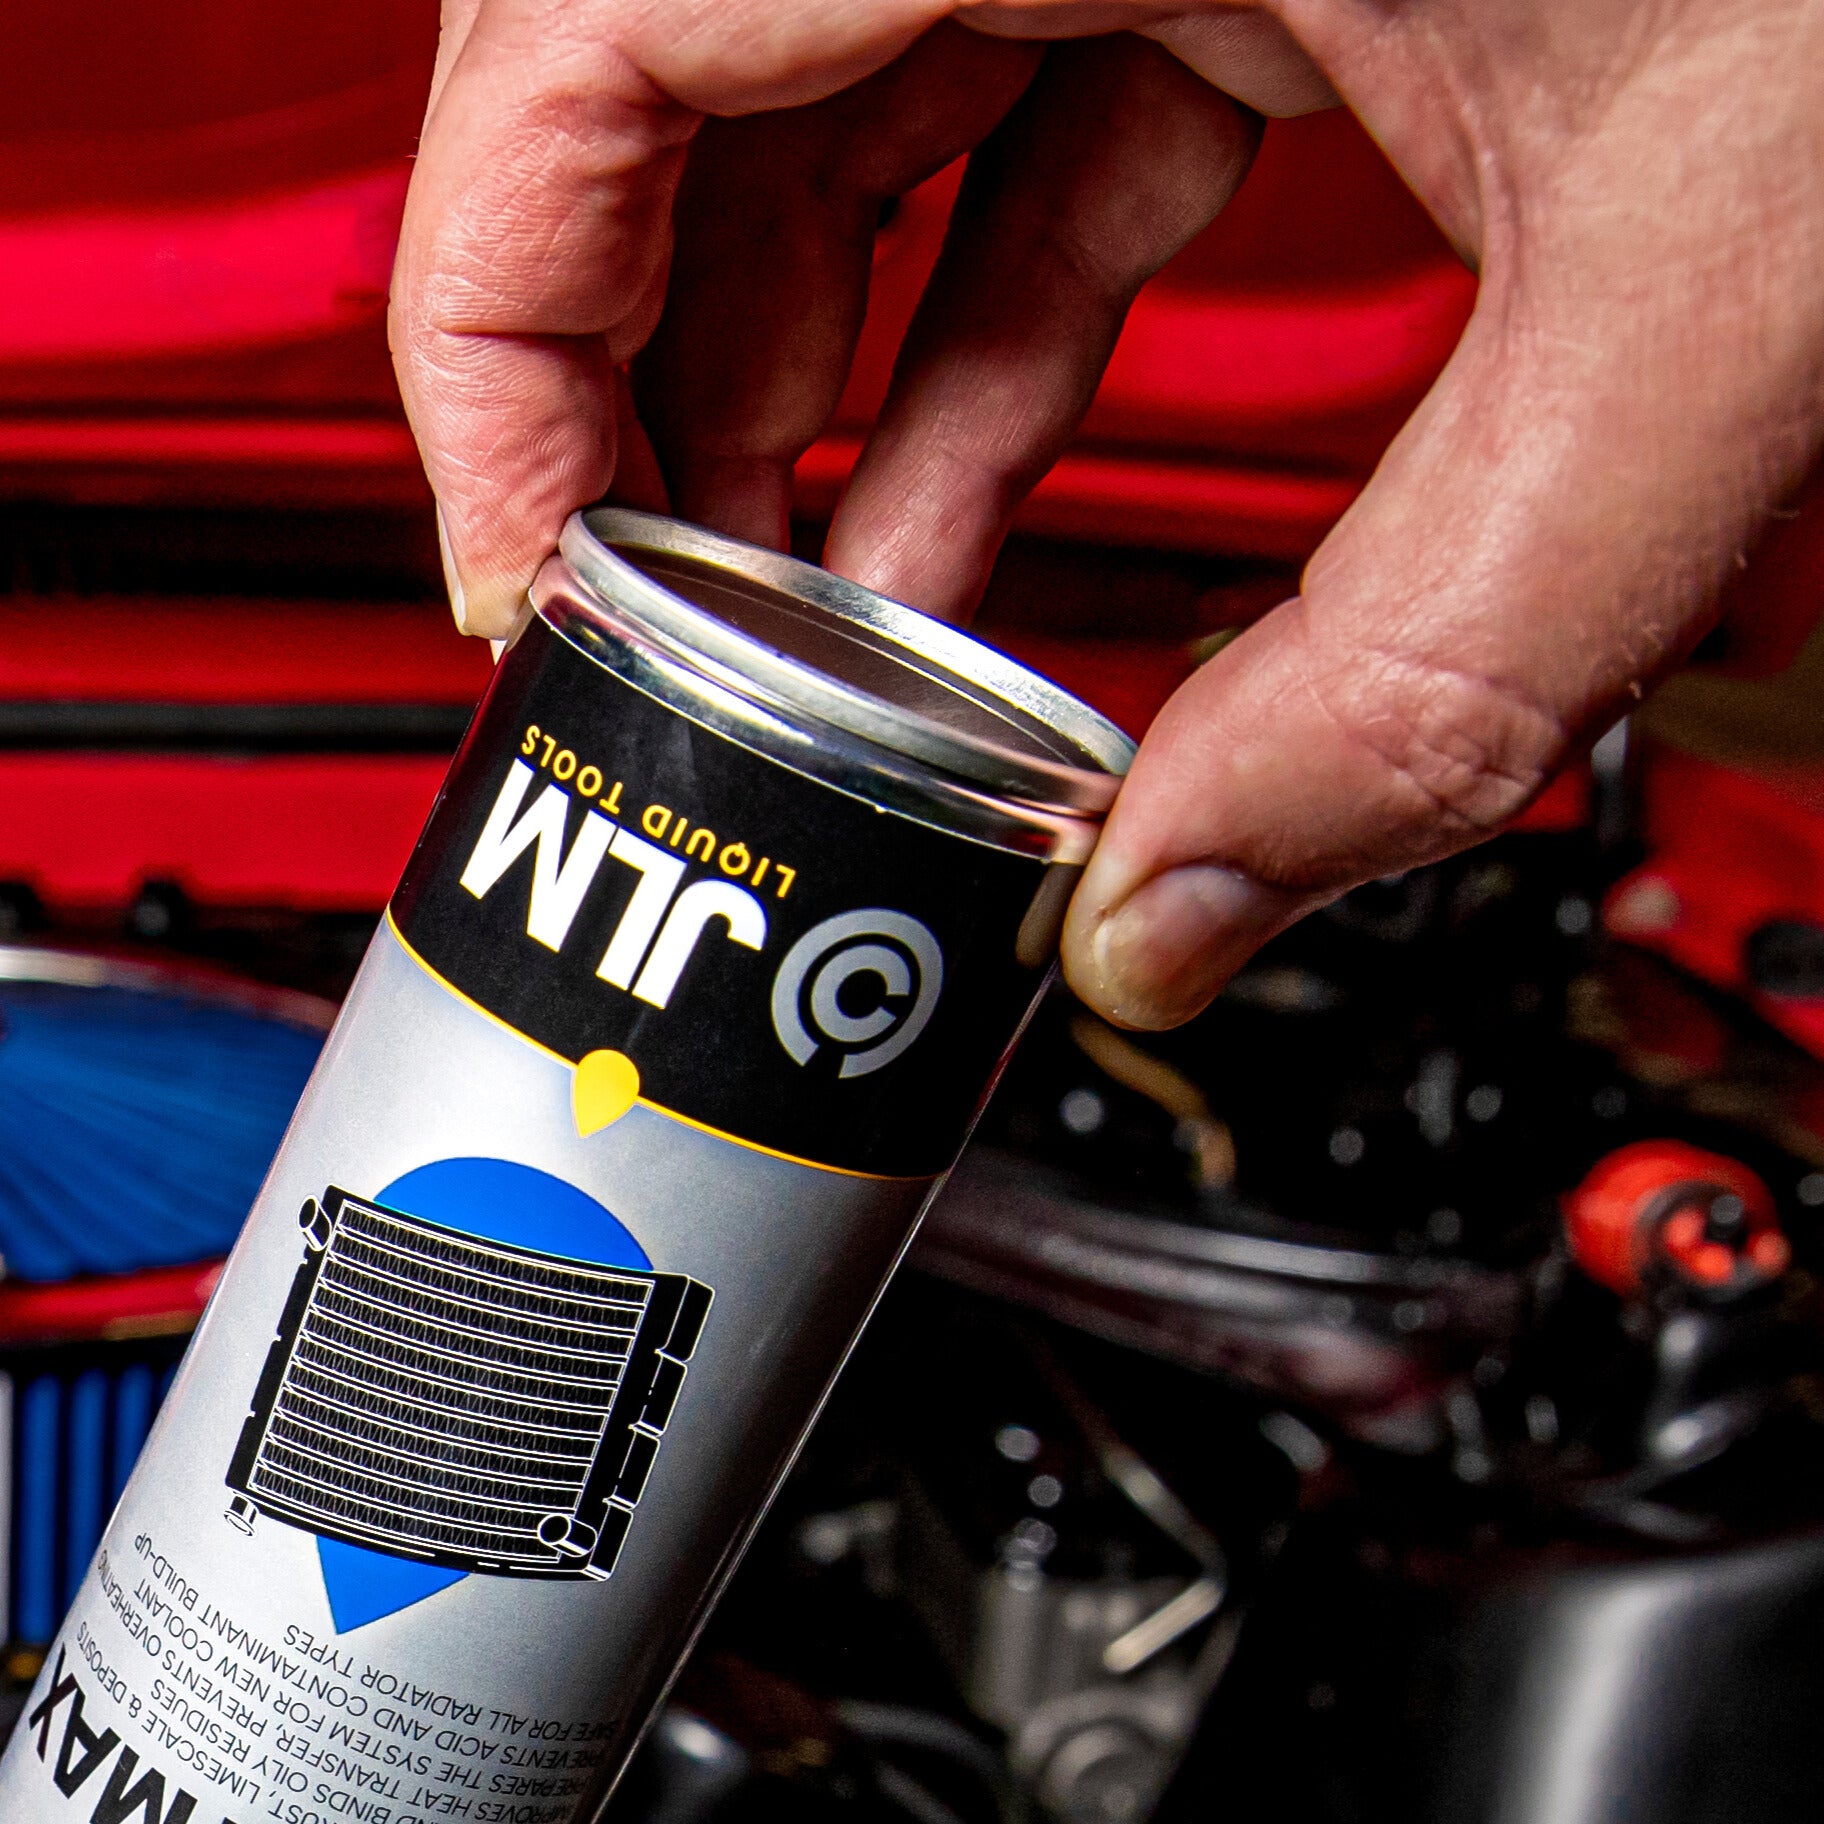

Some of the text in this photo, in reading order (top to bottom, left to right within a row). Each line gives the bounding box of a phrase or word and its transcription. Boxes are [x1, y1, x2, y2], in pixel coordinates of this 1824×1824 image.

[521, 725, 795, 898] LIQUID TOOLS
[460, 757, 767, 1009] JLM
[96, 1549, 162, 1653] OVERHEATING
[75, 1621, 127, 1704] DEPOSITS
[133, 1532, 599, 1769] PREVENTS ACID AND CONTAMINANT BUILD-UP
[133, 1577, 583, 1794] PREPARES THE SYSTEM FOR NEW COOLANT
[283, 1624, 352, 1677] TYPES
[126, 1693, 142, 1717] &
[149, 1678, 250, 1762] RESIDUES
[161, 1649, 267, 1736] PREVENTS
[359, 1664, 482, 1725] RADIATOR
[489, 1709, 528, 1733] ALL
[528, 1719, 573, 1739] FOR
[140, 1709, 261, 1803] LIMESCALE
[251, 1755, 308, 1792] OILY
[276, 1723, 399, 1799] TRANSFER,
[406, 1785, 472, 1816] HEAT
